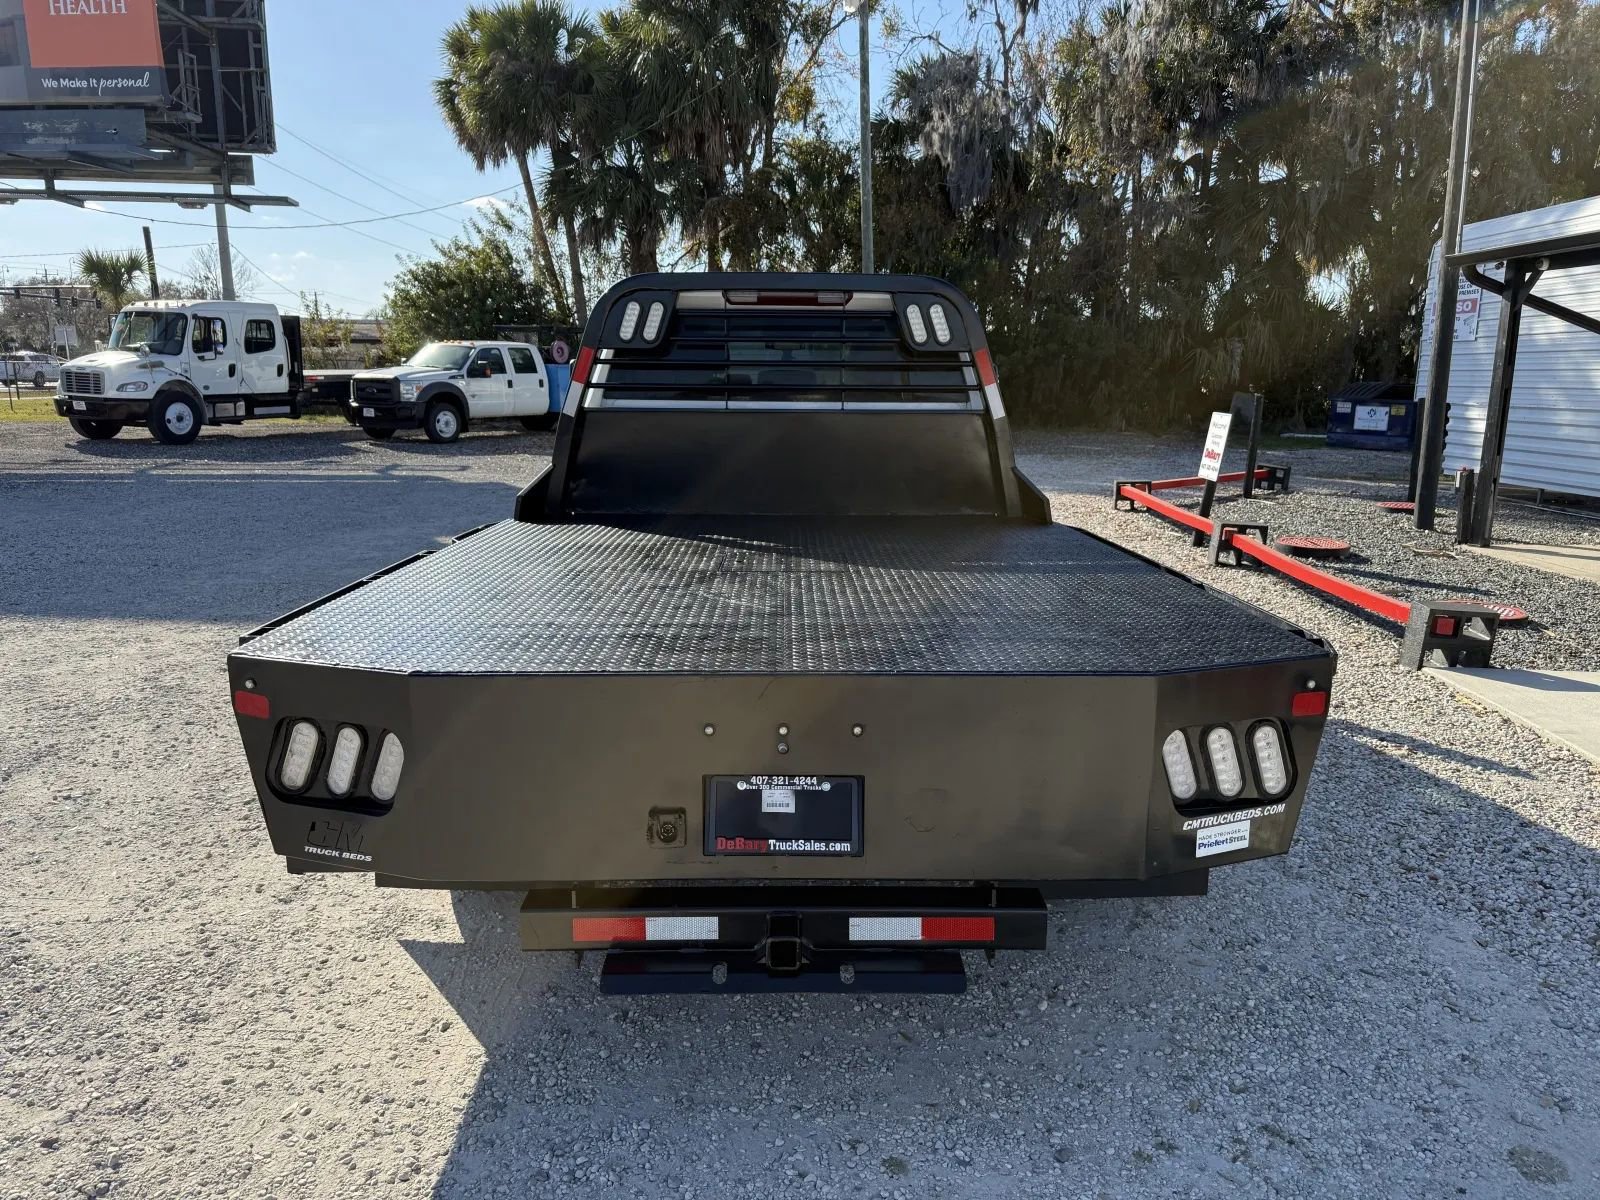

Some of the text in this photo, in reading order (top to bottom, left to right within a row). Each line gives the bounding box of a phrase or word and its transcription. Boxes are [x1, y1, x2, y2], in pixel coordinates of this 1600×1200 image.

[48, 0, 128, 15] HEALTH
[41, 71, 150, 96] We Make It personal
[750, 776, 817, 785] 407-321-4244
[1182, 803, 1286, 831] CMTRUCKBEDS.COM
[304, 845, 373, 862] TRUCK BEDS
